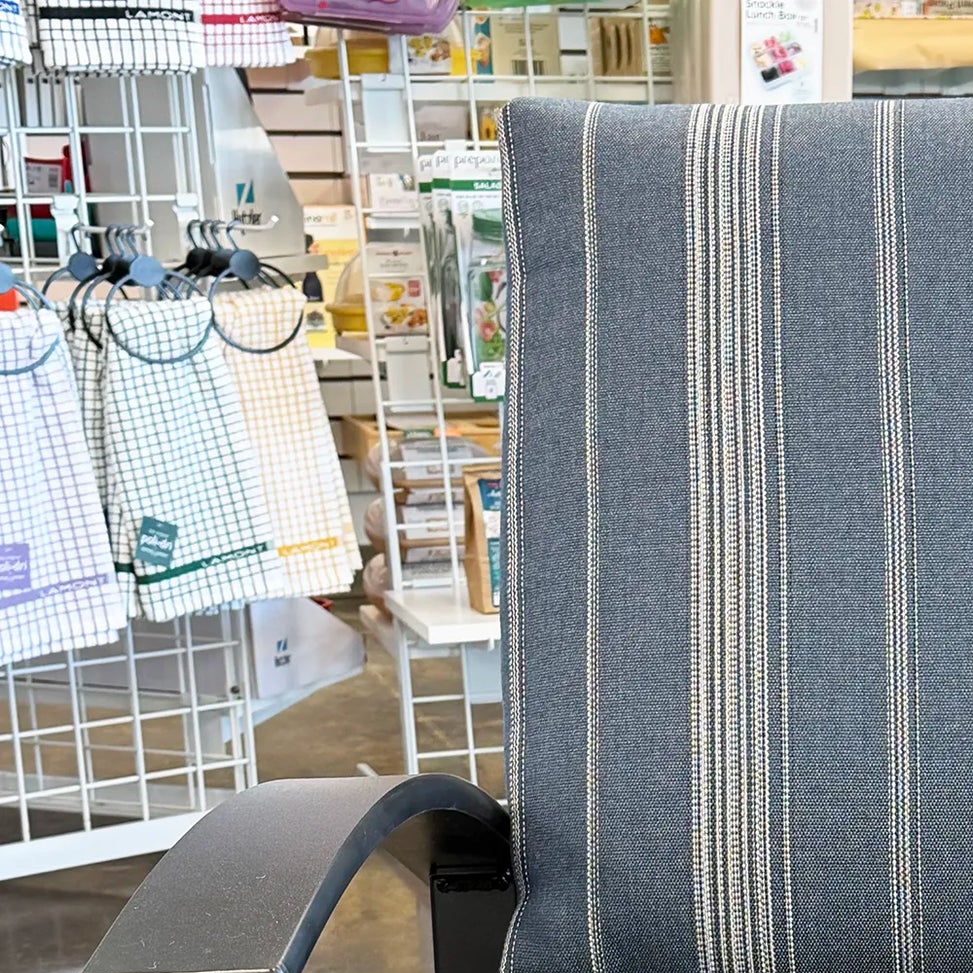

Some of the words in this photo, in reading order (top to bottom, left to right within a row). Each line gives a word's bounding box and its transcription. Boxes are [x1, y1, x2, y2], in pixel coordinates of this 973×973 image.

[125, 9, 191, 21] LAMONT
[239, 14, 280, 23] LAMON
[200, 543, 264, 568] LAMONT
[40, 576, 106, 598] LAMONT
